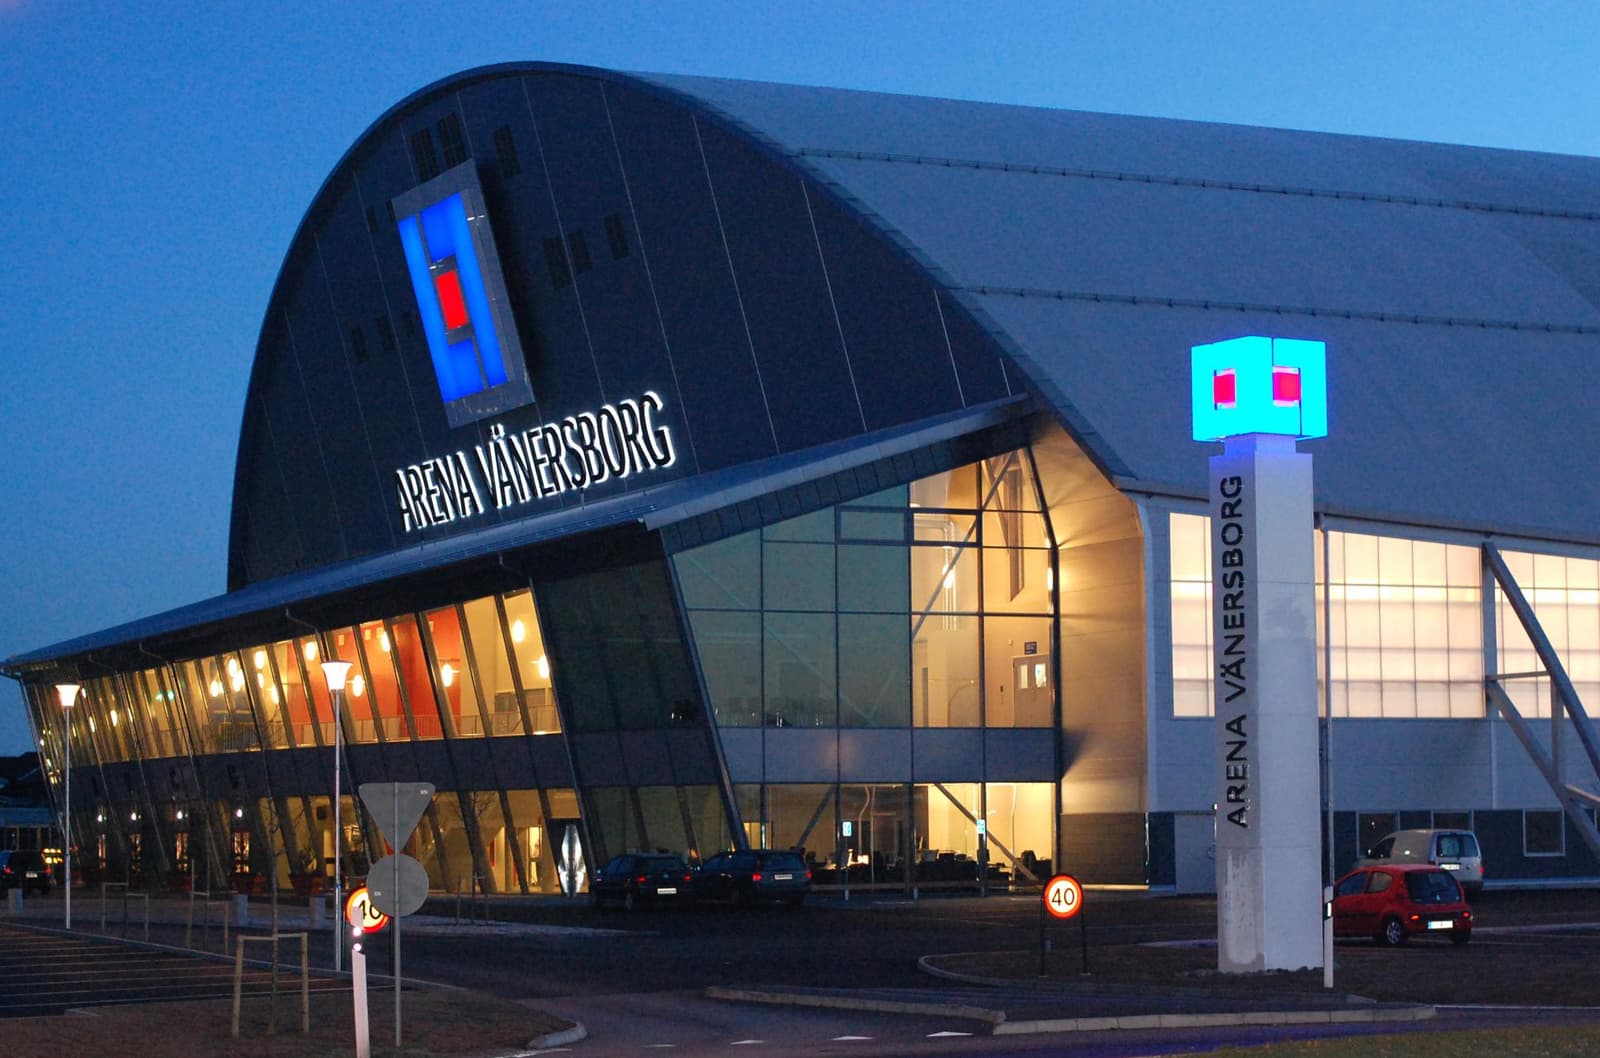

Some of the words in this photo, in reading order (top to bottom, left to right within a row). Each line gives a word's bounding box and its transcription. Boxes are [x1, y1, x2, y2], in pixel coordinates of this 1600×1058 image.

[396, 450, 484, 532] ARENA
[474, 391, 676, 509] VÄNERSBORG
[1219, 475, 1246, 703] VÄNERSBORG
[1225, 713, 1249, 828] ARENA
[1051, 888, 1075, 906] 40
